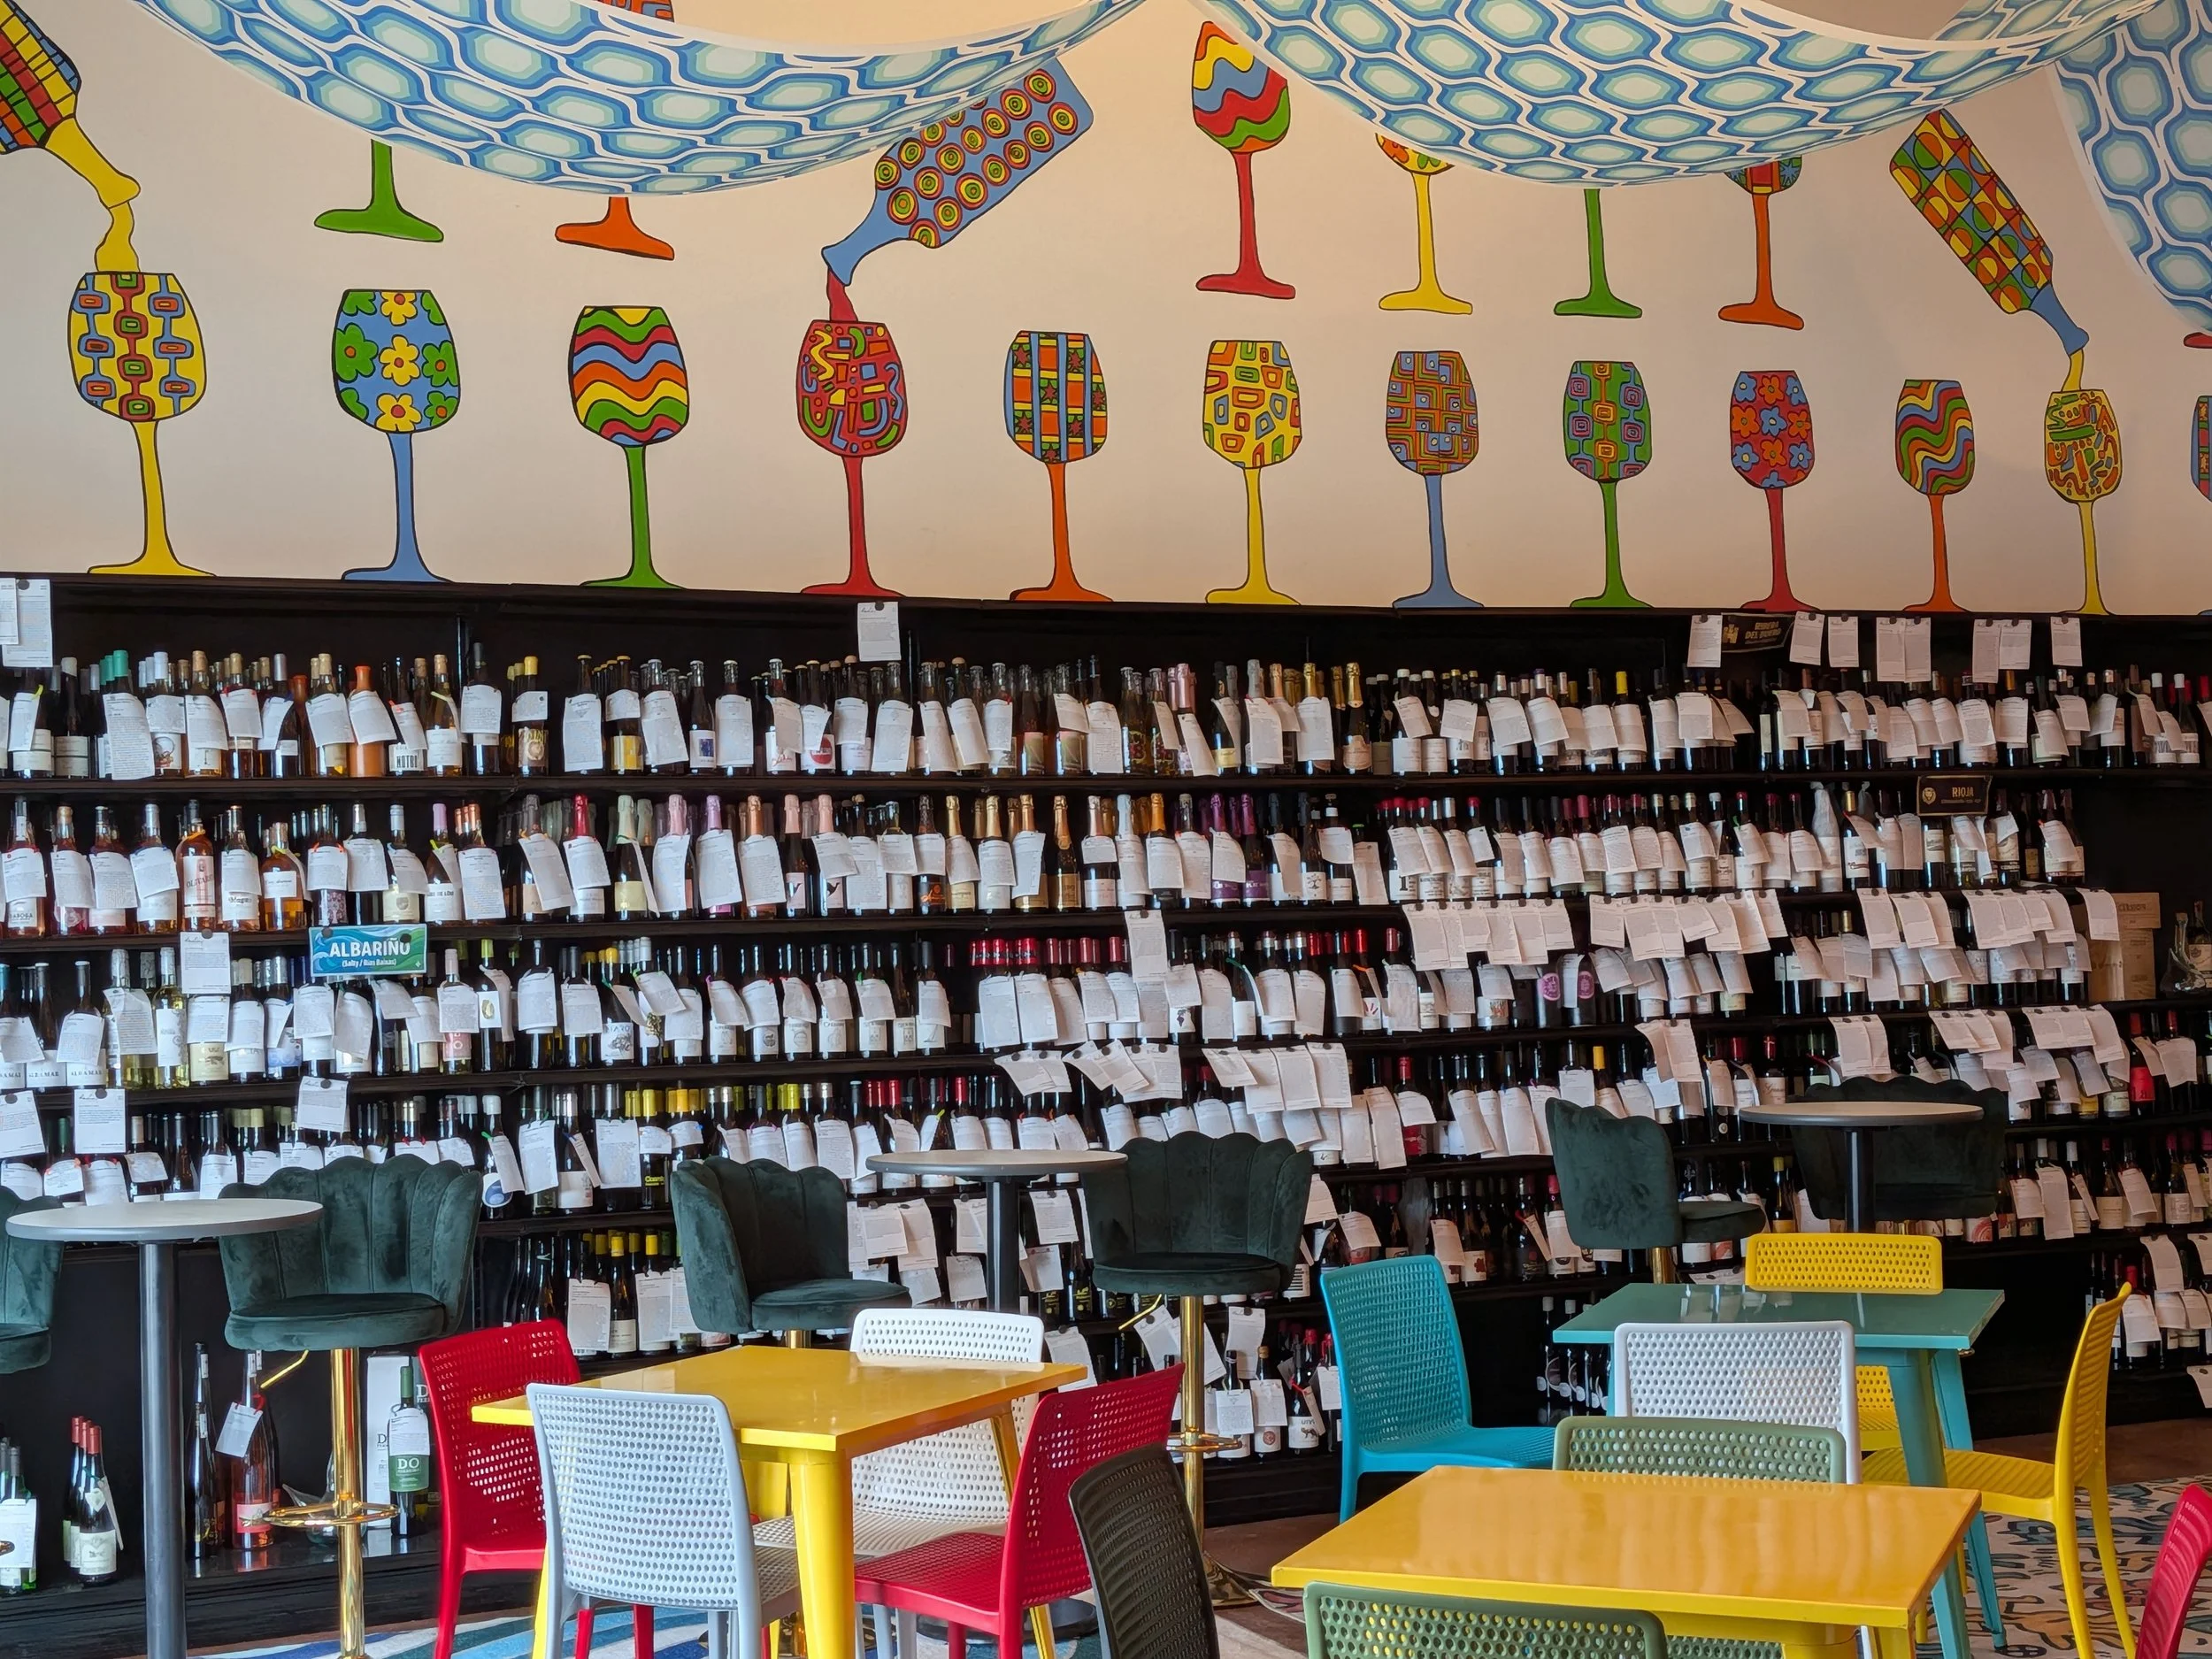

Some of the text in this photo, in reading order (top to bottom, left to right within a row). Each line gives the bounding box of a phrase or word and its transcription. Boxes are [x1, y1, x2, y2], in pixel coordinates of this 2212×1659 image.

[1952, 787, 1975, 798] RIOJA
[329, 938, 411, 957] ALBARIÑO
[397, 1457, 420, 1469] DO
